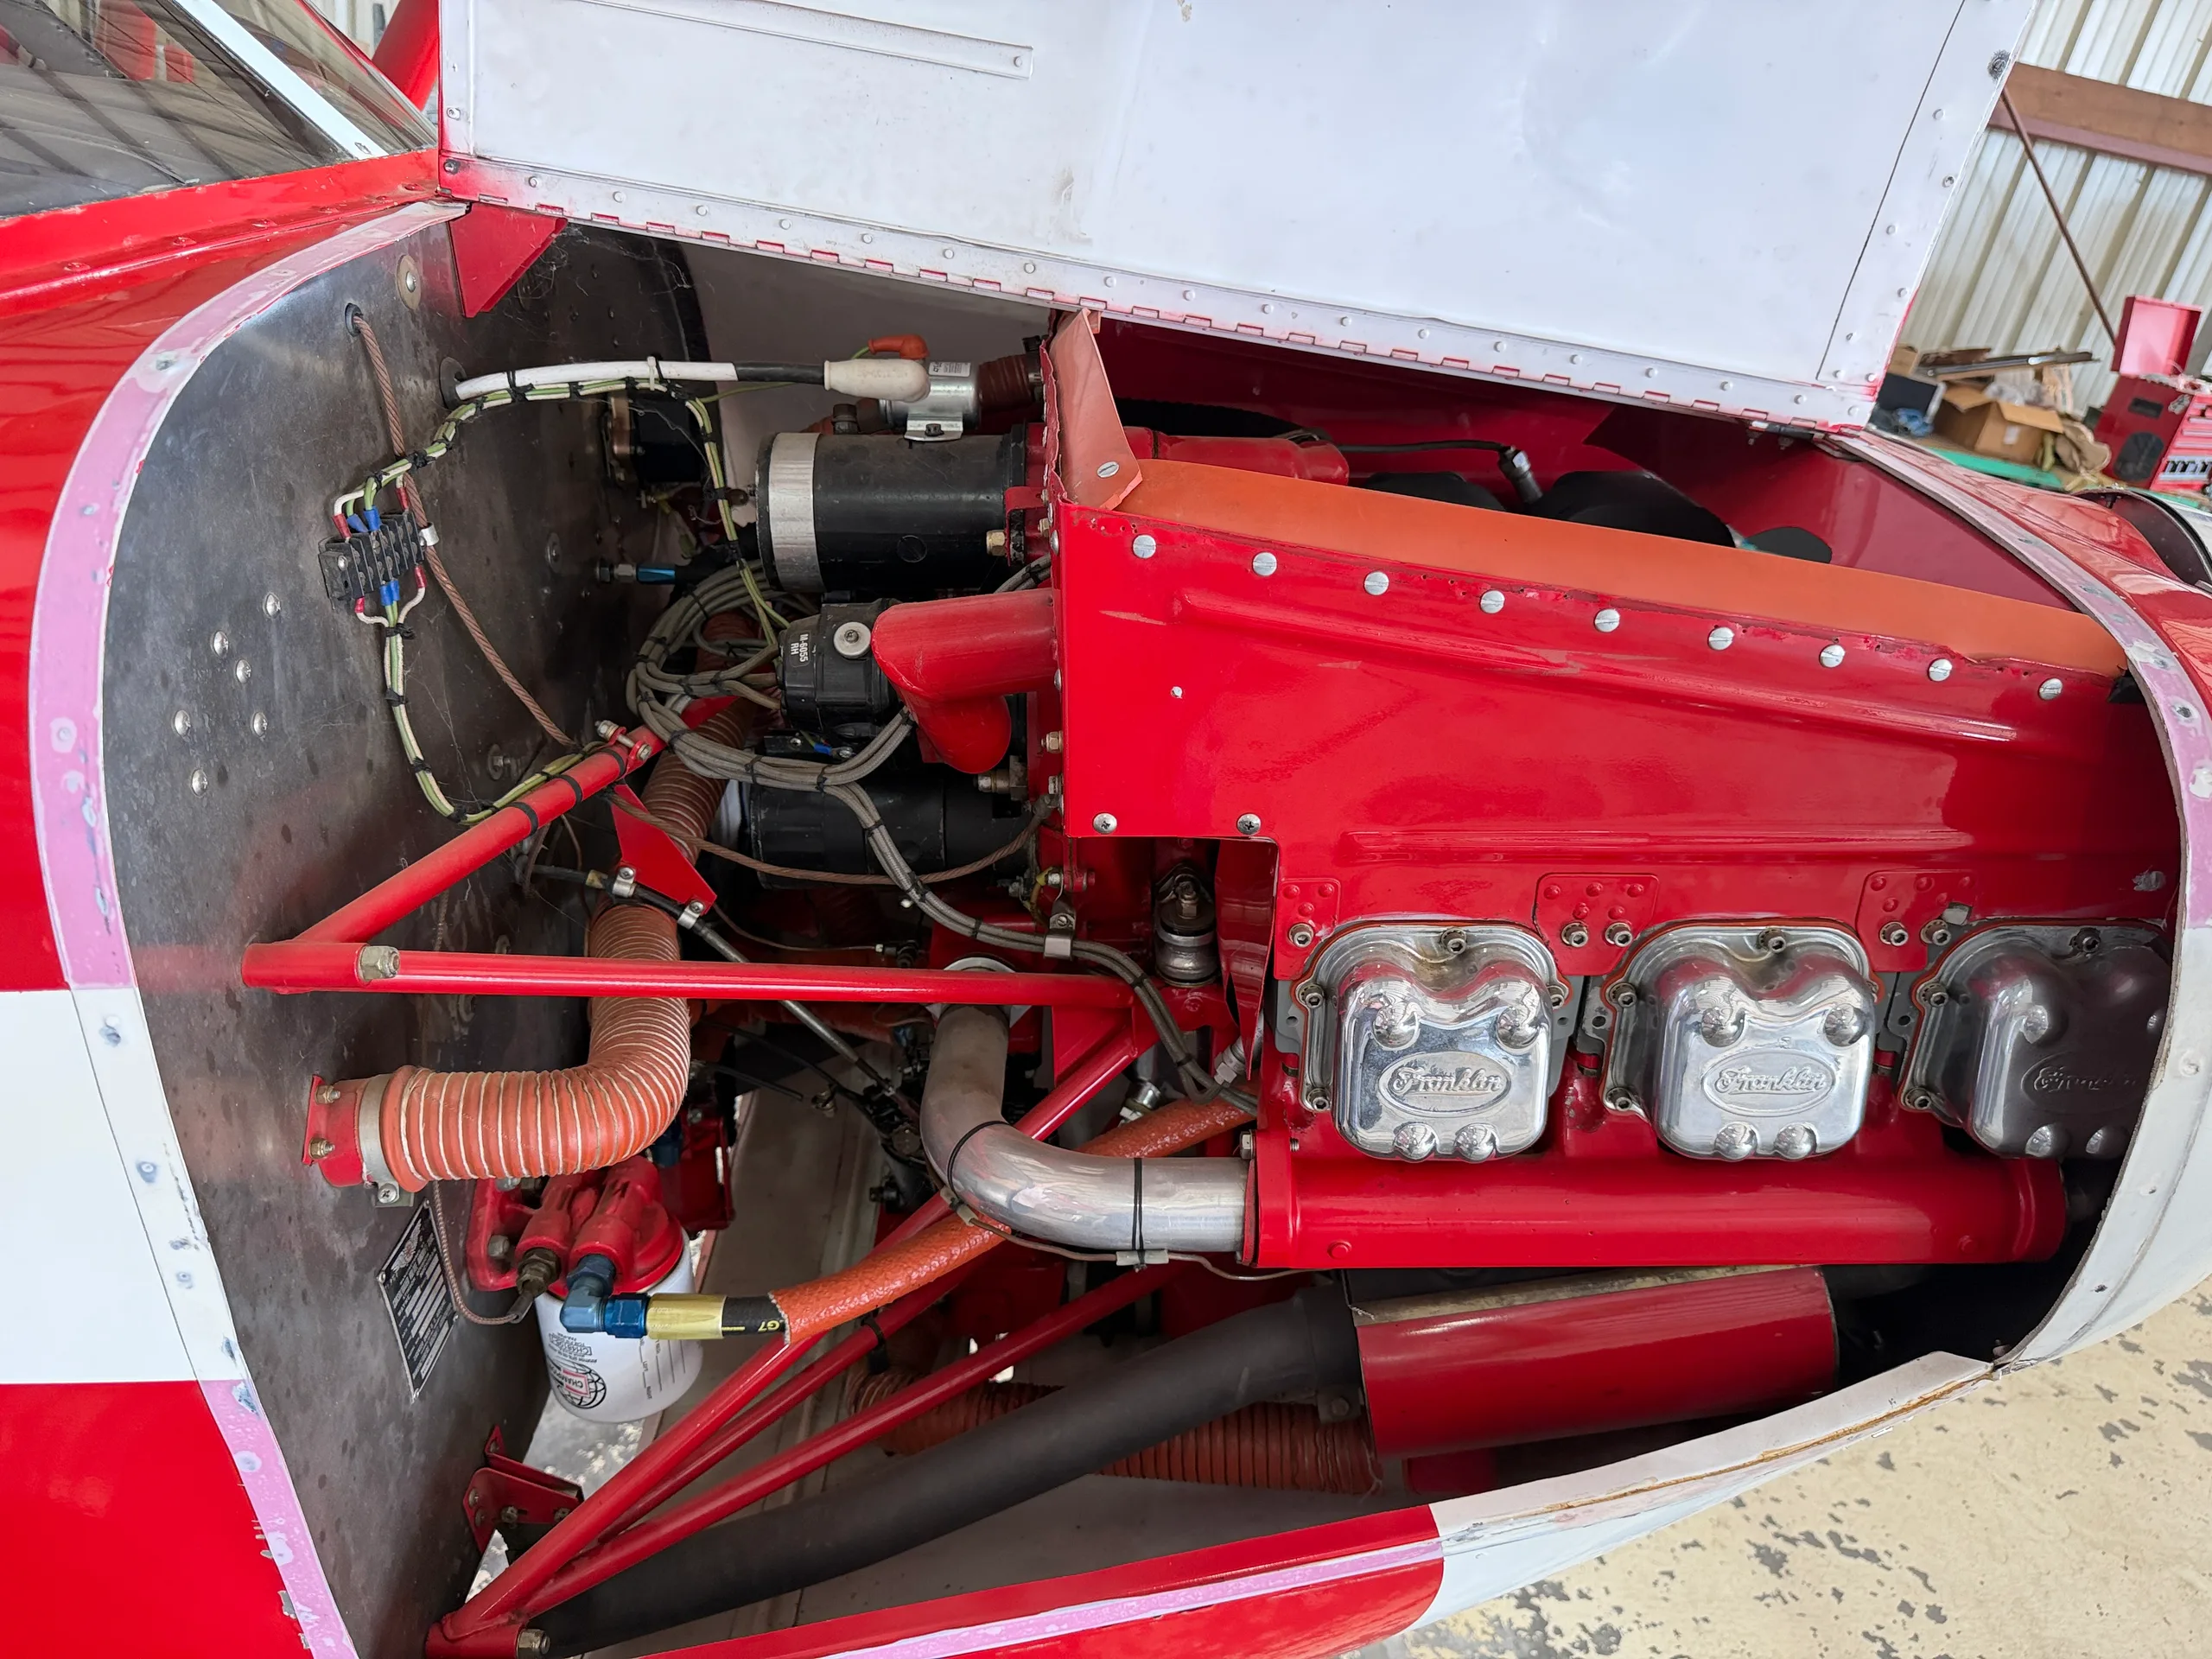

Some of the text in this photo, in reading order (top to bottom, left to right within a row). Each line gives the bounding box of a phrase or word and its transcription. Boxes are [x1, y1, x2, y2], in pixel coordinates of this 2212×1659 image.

[791, 643, 799, 655] RH
[799, 633, 808, 662] M-6055
[1392, 1066, 1502, 1096] Franklin
[1714, 1065, 1827, 1095] Franklin
[2034, 1066, 2139, 1093] Fran
[550, 1364, 583, 1389] CHAMP
